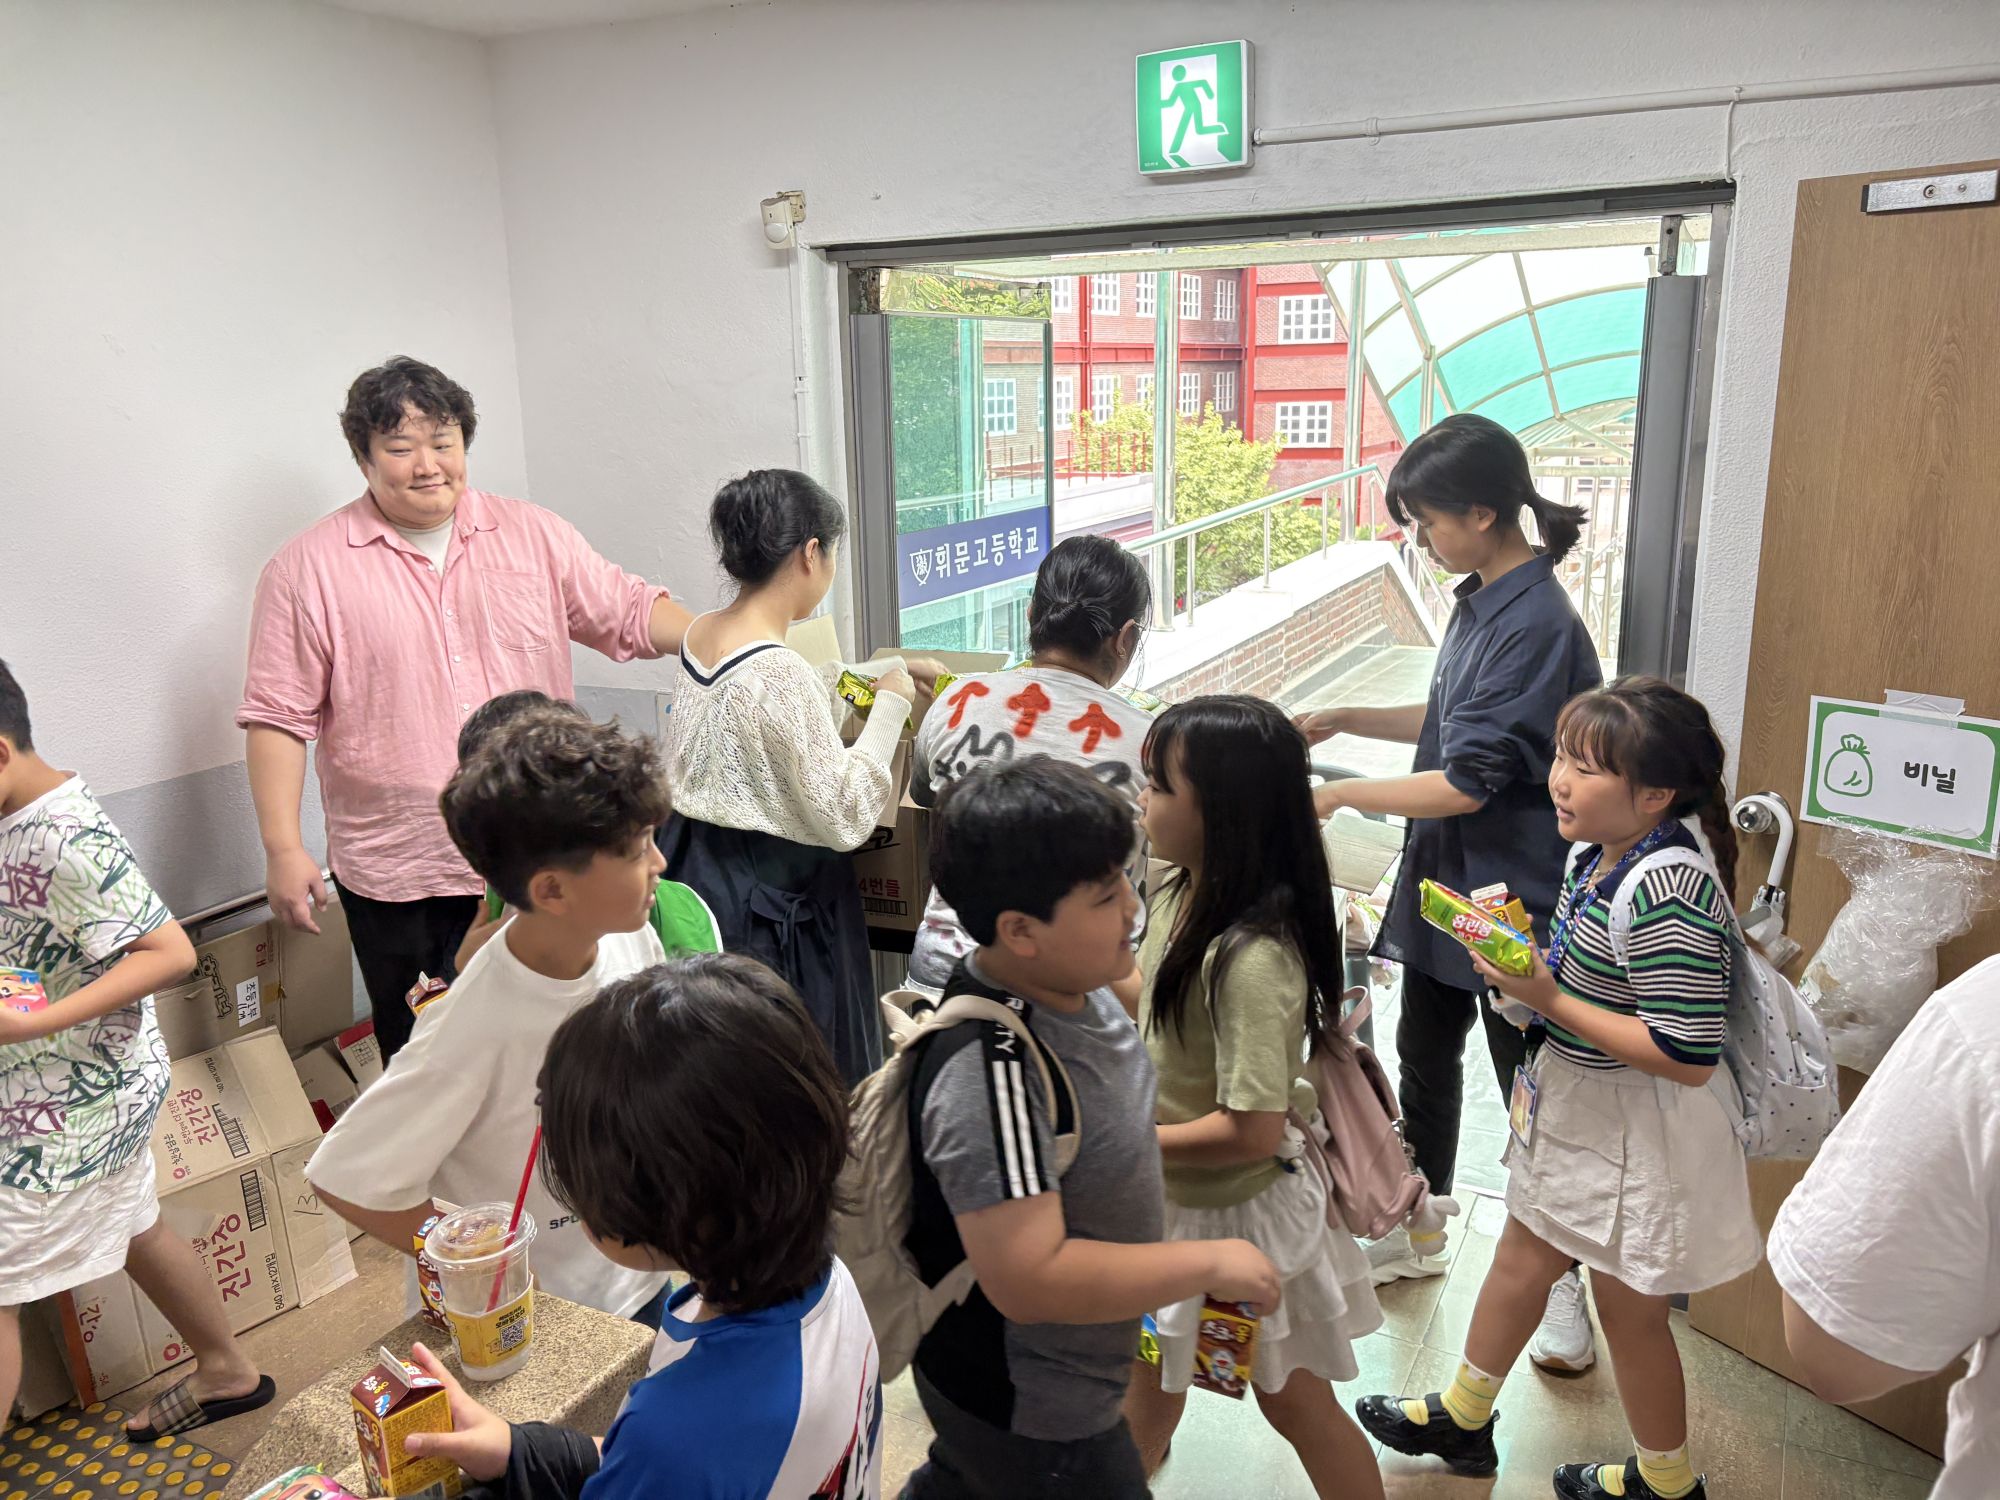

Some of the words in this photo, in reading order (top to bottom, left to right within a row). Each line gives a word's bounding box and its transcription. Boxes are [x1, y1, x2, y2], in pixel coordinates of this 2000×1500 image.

[935, 526, 1039, 579] 휘문고등학교
[1903, 761, 1956, 795] 비닐
[177, 1088, 219, 1145] 진간장
